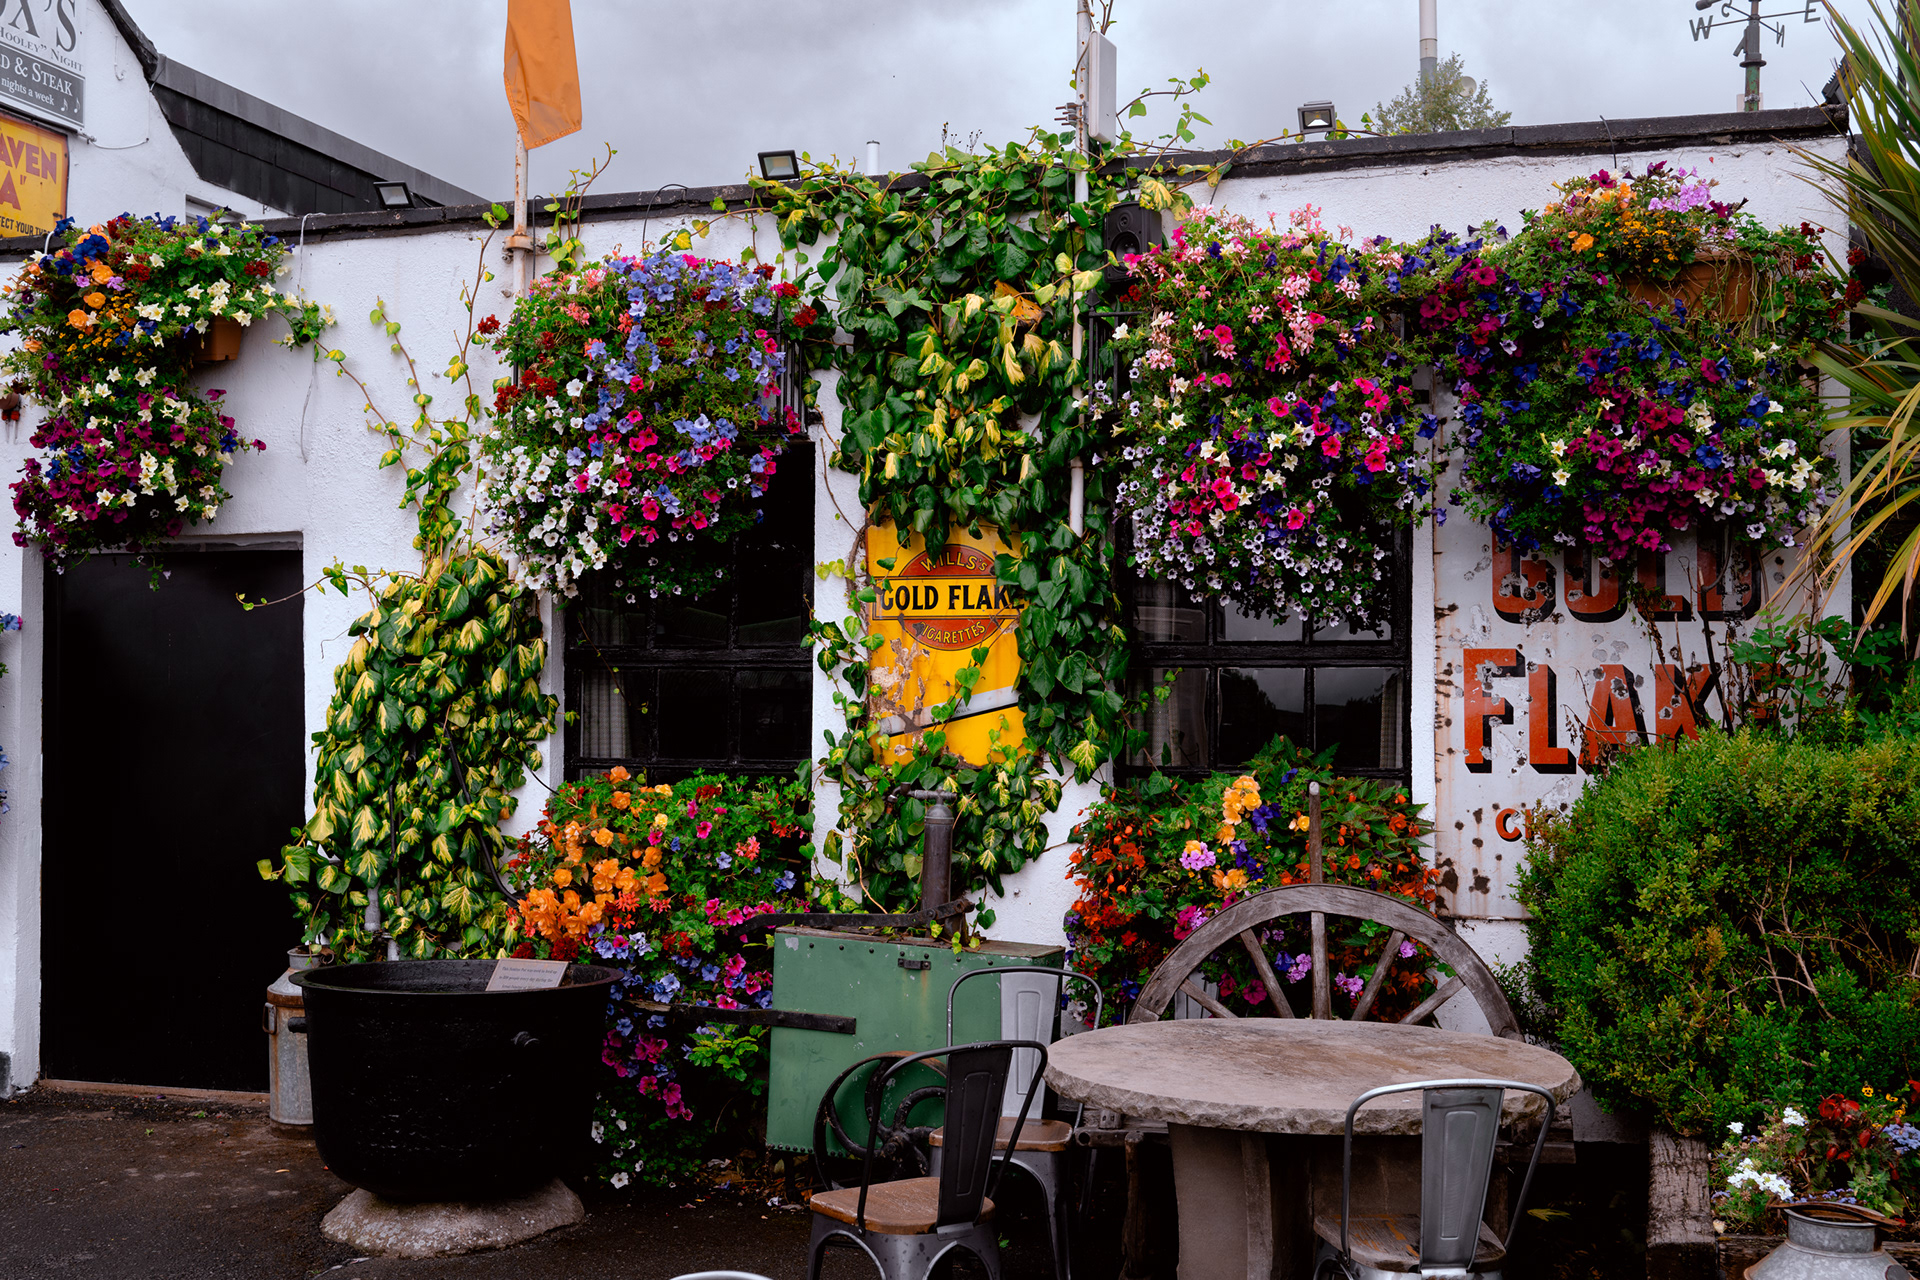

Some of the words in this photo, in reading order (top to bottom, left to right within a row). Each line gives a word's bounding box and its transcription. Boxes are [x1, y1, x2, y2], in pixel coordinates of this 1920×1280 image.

[0, 0, 76, 52] X'S
[1689, 15, 1713, 42] W
[15, 56, 28, 77] &
[1, 77, 27, 94] nights
[28, 88, 33, 97] a
[34, 90, 55, 106] week
[16, 218, 34, 236] YOUR
[881, 585, 939, 611] GOLD
[948, 585, 1025, 610] FLAK
[919, 619, 986, 644] IGARETTES
